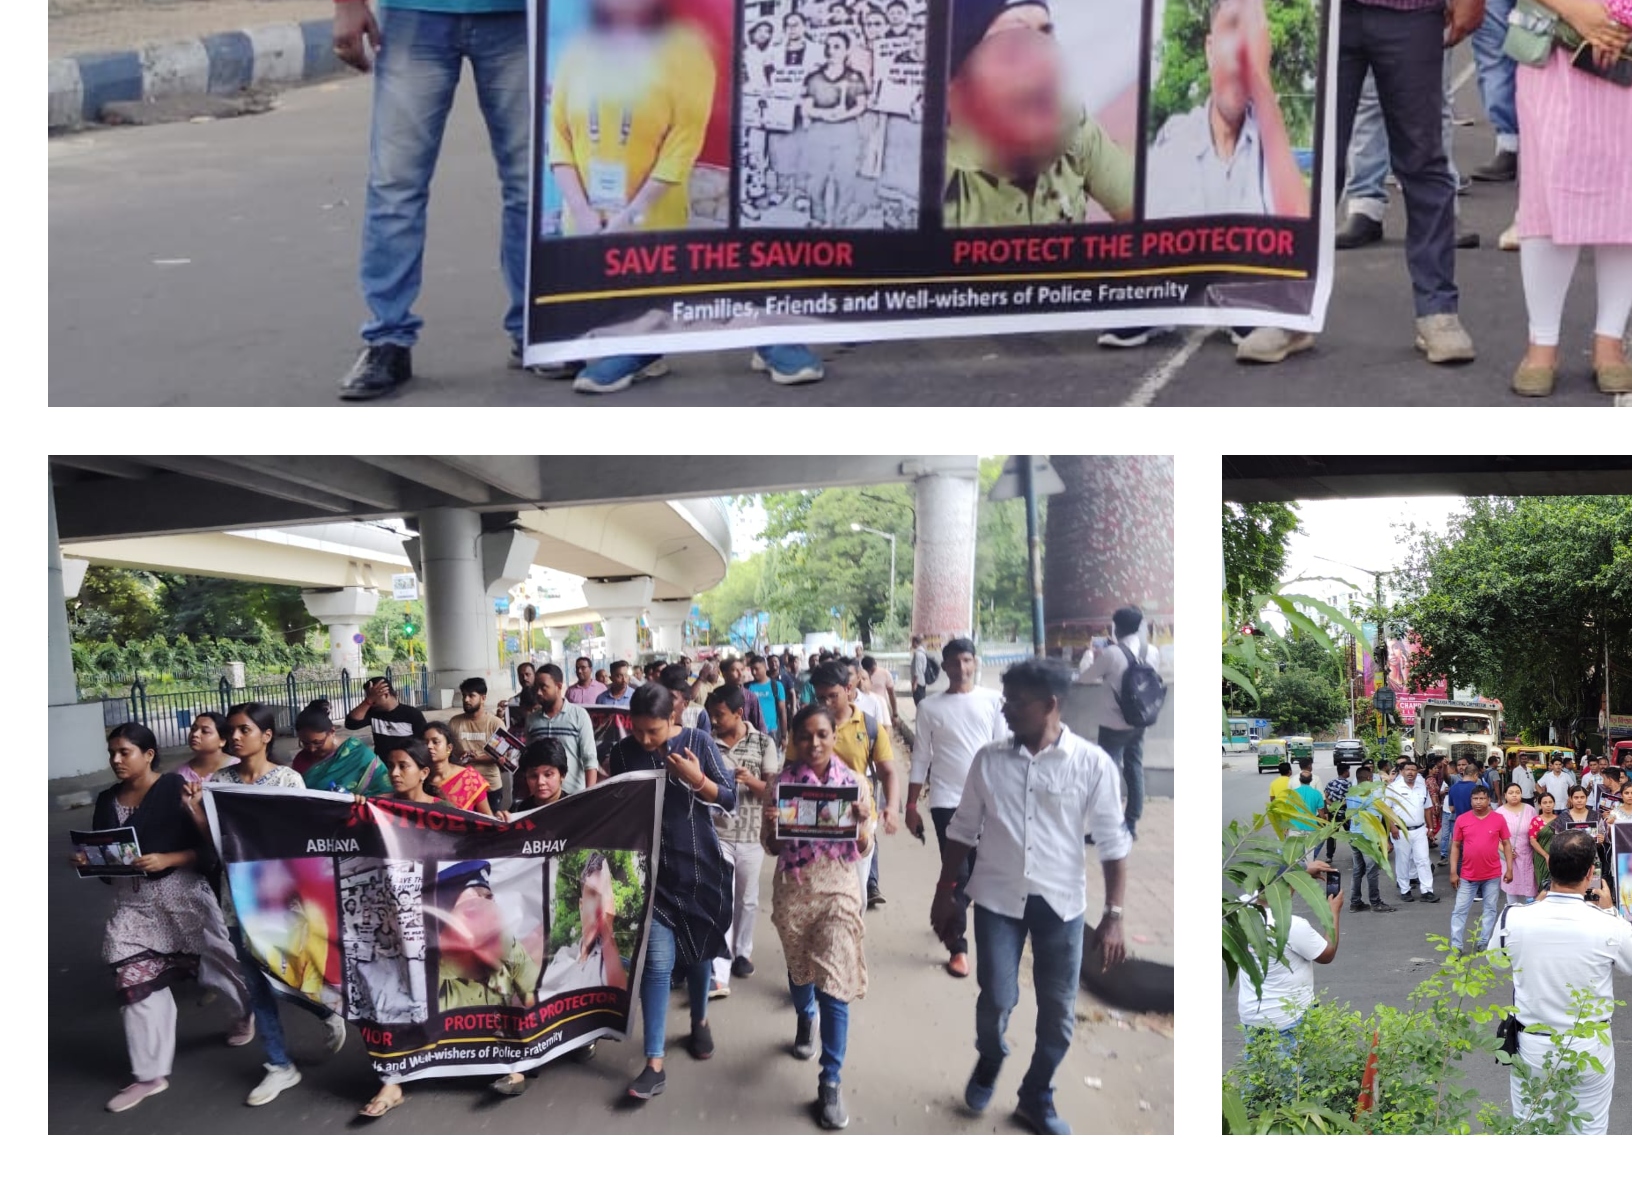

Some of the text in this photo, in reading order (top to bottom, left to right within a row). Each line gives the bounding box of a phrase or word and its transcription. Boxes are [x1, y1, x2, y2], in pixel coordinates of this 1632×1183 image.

[605, 241, 853, 276] SAVE THE SAVIOR
[954, 227, 1294, 264] PROTECT THE PROTECTOR
[672, 280, 1189, 322] Families, Friends and Well-wishers of Police Fraternity
[306, 839, 360, 853] ABHAYA
[522, 839, 568, 854] ABHAY
[444, 992, 618, 1032] PROTECT THE PROTECTOR
[385, 1058, 407, 1072] and
[409, 1047, 476, 1067] Well-wishers
[478, 1045, 490, 1060] of
[492, 1046, 521, 1059] Police
[524, 1029, 563, 1057] Fraternity
